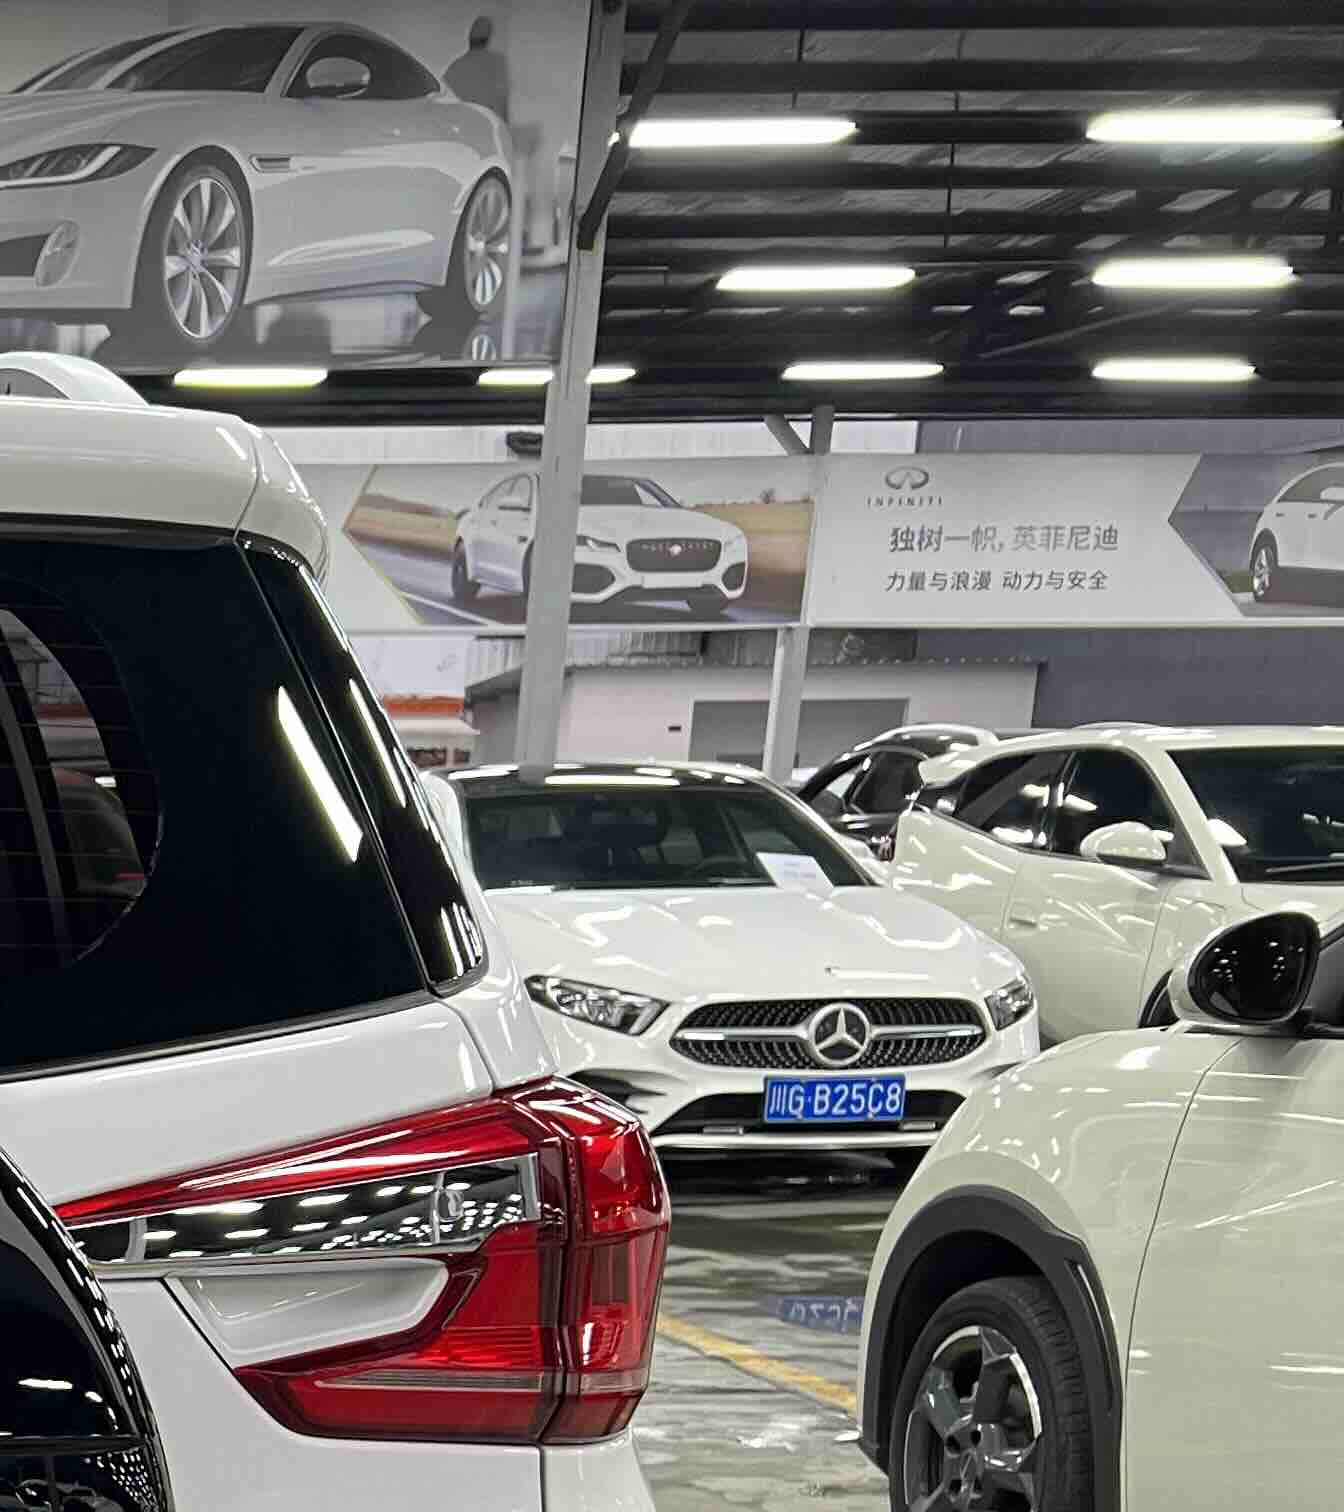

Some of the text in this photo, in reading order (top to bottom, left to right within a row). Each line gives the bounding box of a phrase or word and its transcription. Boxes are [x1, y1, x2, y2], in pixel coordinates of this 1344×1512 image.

[885, 568, 1109, 592] 力量与浪漫 动力与安全
